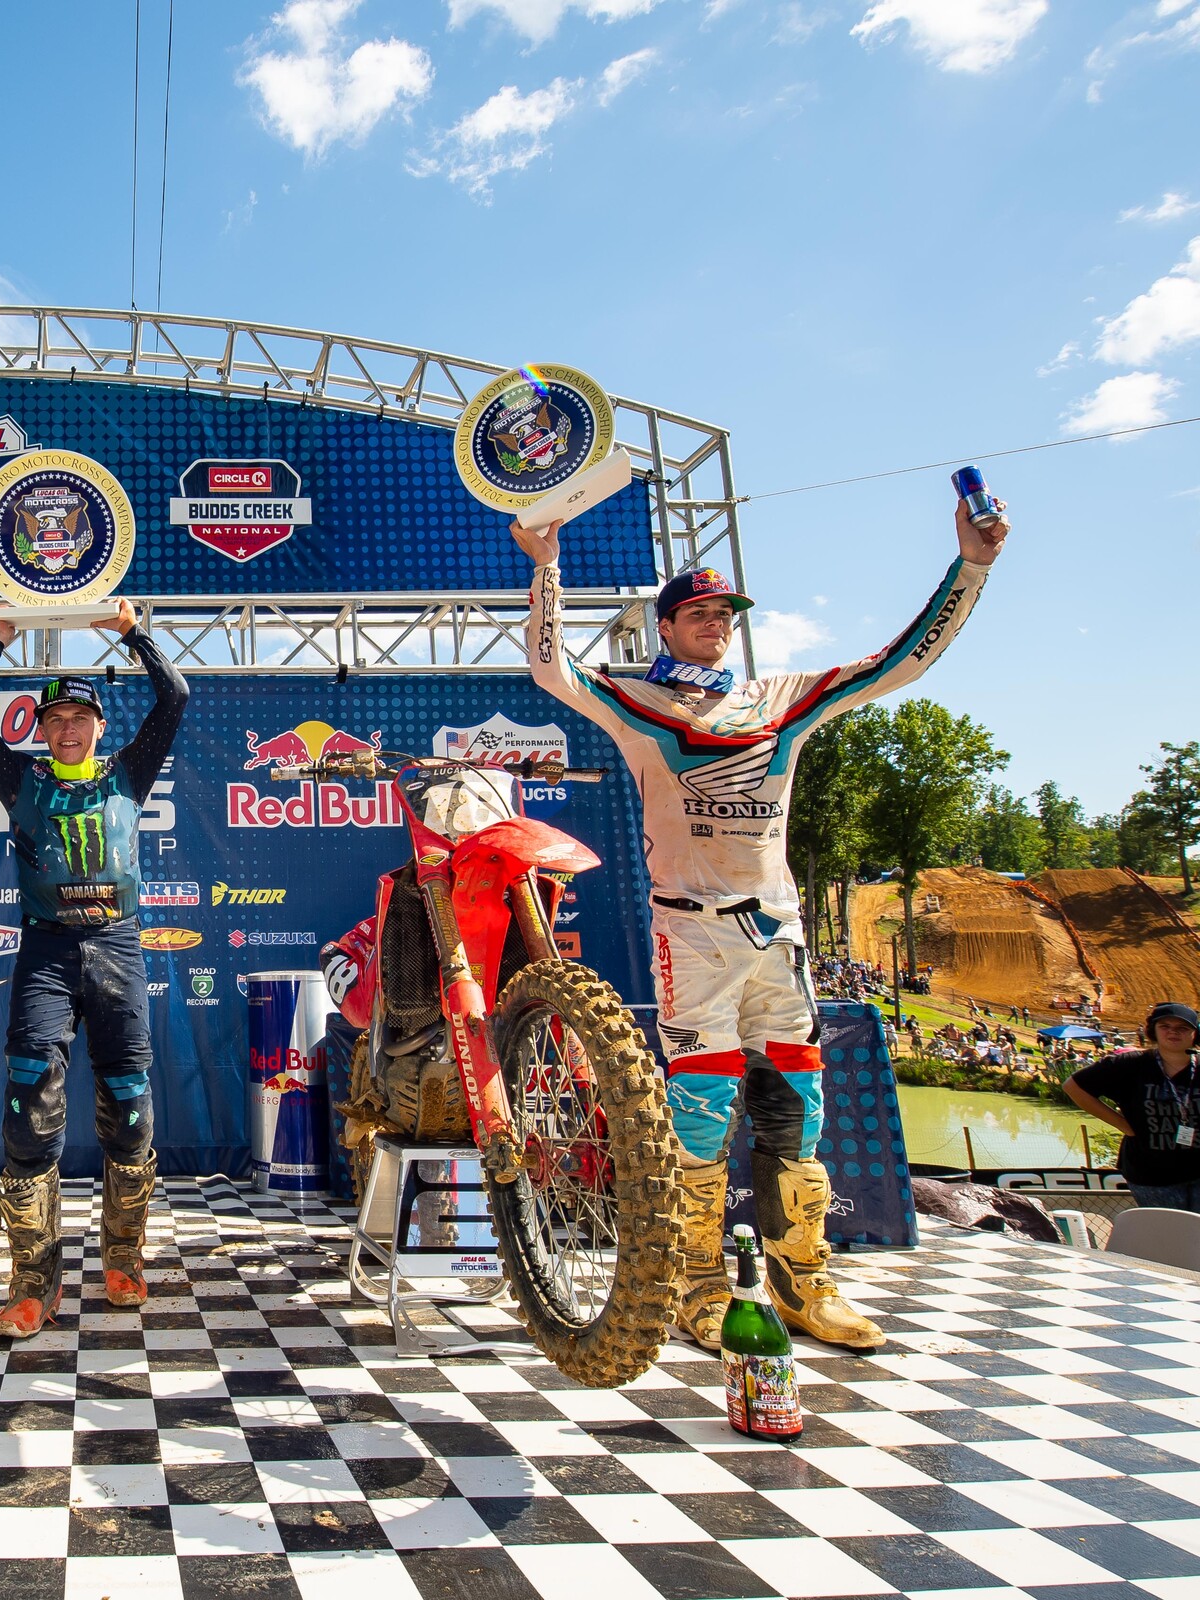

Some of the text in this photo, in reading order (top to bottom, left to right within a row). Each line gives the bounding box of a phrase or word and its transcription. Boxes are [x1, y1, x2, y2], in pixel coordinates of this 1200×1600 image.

[554, 368, 611, 439] CHAMPIONSHIP
[463, 407, 480, 429] PRO
[493, 397, 542, 431] MOTOCROSS
[457, 428, 470, 452] OIL
[213, 471, 267, 486] CIRCLE K
[459, 453, 484, 489] LUCAS
[36, 489, 56, 497] LUCAS
[24, 497, 79, 507] MOTOCROSS
[20, 454, 102, 480] MOTOCROSS
[101, 477, 132, 575] CHAMPIONSHIP
[188, 503, 294, 519] BUDDS CREEK
[202, 527, 281, 535] NATIONAL
[16, 590, 44, 607] FIRST
[83, 588, 99, 603] 250
[910, 586, 967, 662] HONDA
[668, 662, 734, 693] 100%
[72, 682, 93, 692] YAMAHA
[504, 739, 565, 747] PERFORMANCE
[433, 766, 467, 776] LUCAS
[228, 782, 404, 828] Red Bull
[685, 800, 784, 818] HONDA
[60, 886, 115, 900] YAMALUBE
[228, 888, 287, 904] THOR
[87, 907, 102, 915] BELL
[248, 932, 317, 945] SUZUKI
[188, 967, 217, 975] ROAD
[656, 932, 676, 1021] ASTARS
[197, 981, 208, 995] 2
[186, 998, 220, 1006] RECOVERY
[669, 1042, 708, 1057] HONDA
[250, 1048, 327, 1071] Red Bull
[450, 1012, 483, 1111] DUNLOP
[271, 1165, 295, 1174] Vitalizes
[295, 1166, 312, 1175] body
